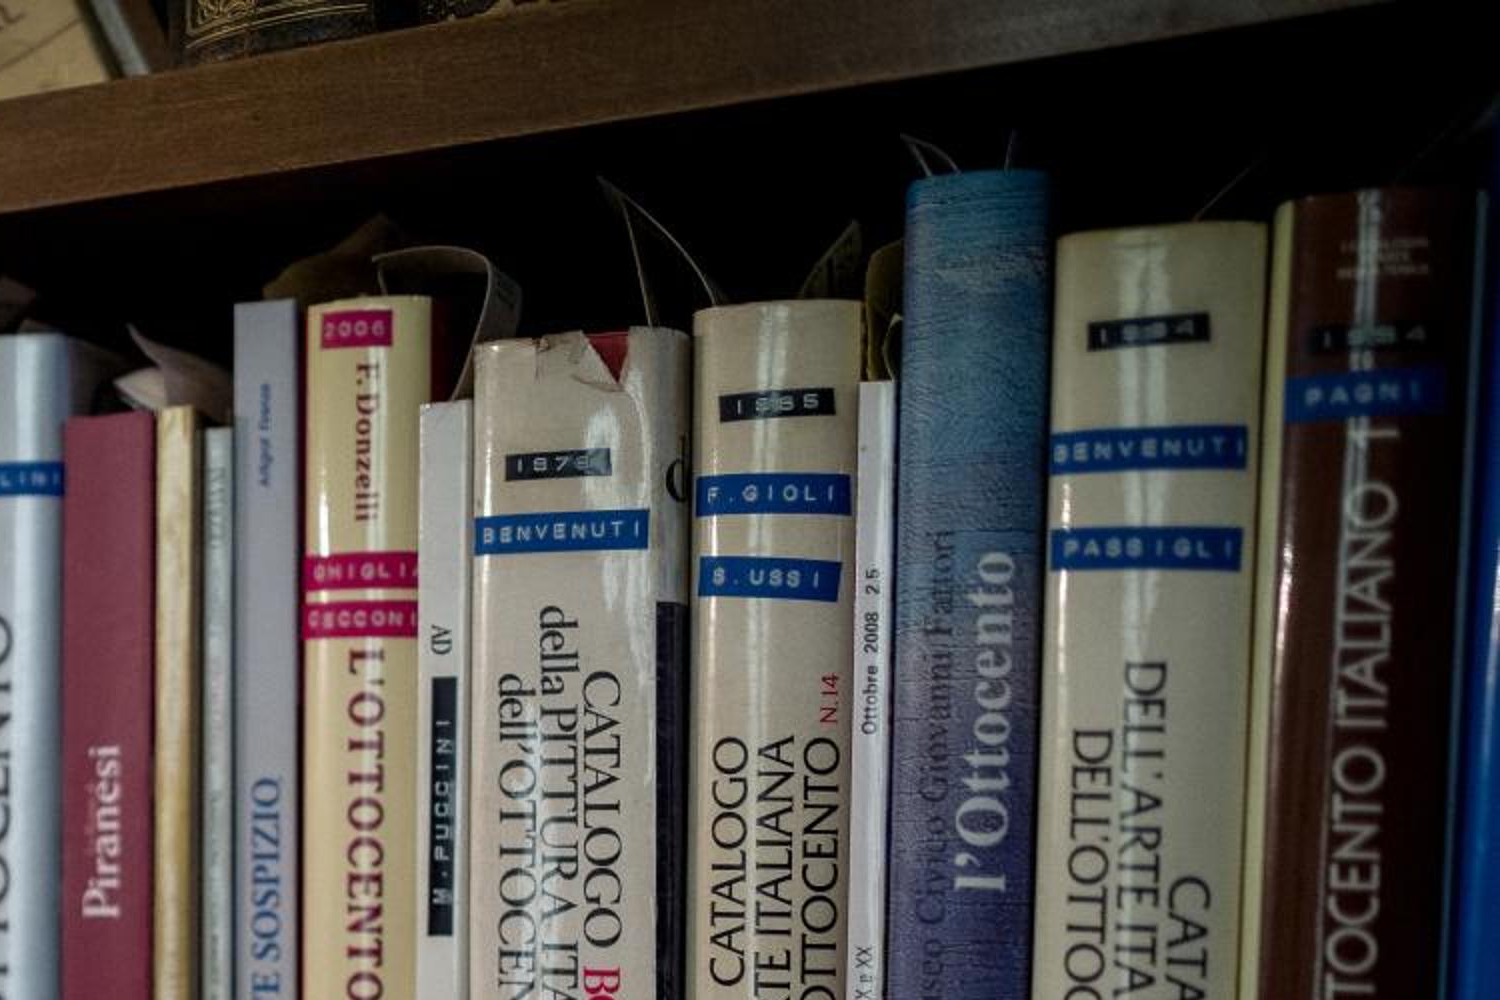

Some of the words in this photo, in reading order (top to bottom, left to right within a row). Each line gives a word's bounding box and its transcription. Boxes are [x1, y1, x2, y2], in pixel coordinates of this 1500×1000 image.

[1053, 437, 1246, 464] BENVENUTI
[1304, 382, 1422, 408] PAGNI
[355, 390, 381, 522] Donzelli
[707, 484, 835, 505] F.GIOLI
[482, 520, 641, 545] BENVENUTI
[712, 567, 819, 588] S.USSI
[1062, 535, 1234, 559] PASSIGLI
[431, 625, 453, 655] AD
[539, 604, 579, 692] della
[863, 610, 880, 655] 2008
[1330, 484, 1399, 728] ITALIANO
[861, 664, 878, 735] Ottobre
[919, 653, 951, 804] Giovanni
[953, 551, 1016, 894] l'Ottocento
[81, 744, 123, 920] Piranesi
[539, 703, 579, 917] PITTURA
[583, 671, 623, 947] CATALOGO
[754, 736, 795, 938] ITALIANA
[1116, 660, 1168, 910] DELL'ARTE
[250, 775, 285, 962] SOSPIZIO
[709, 737, 748, 988] CATALOGO
[914, 818, 948, 926] Civico
